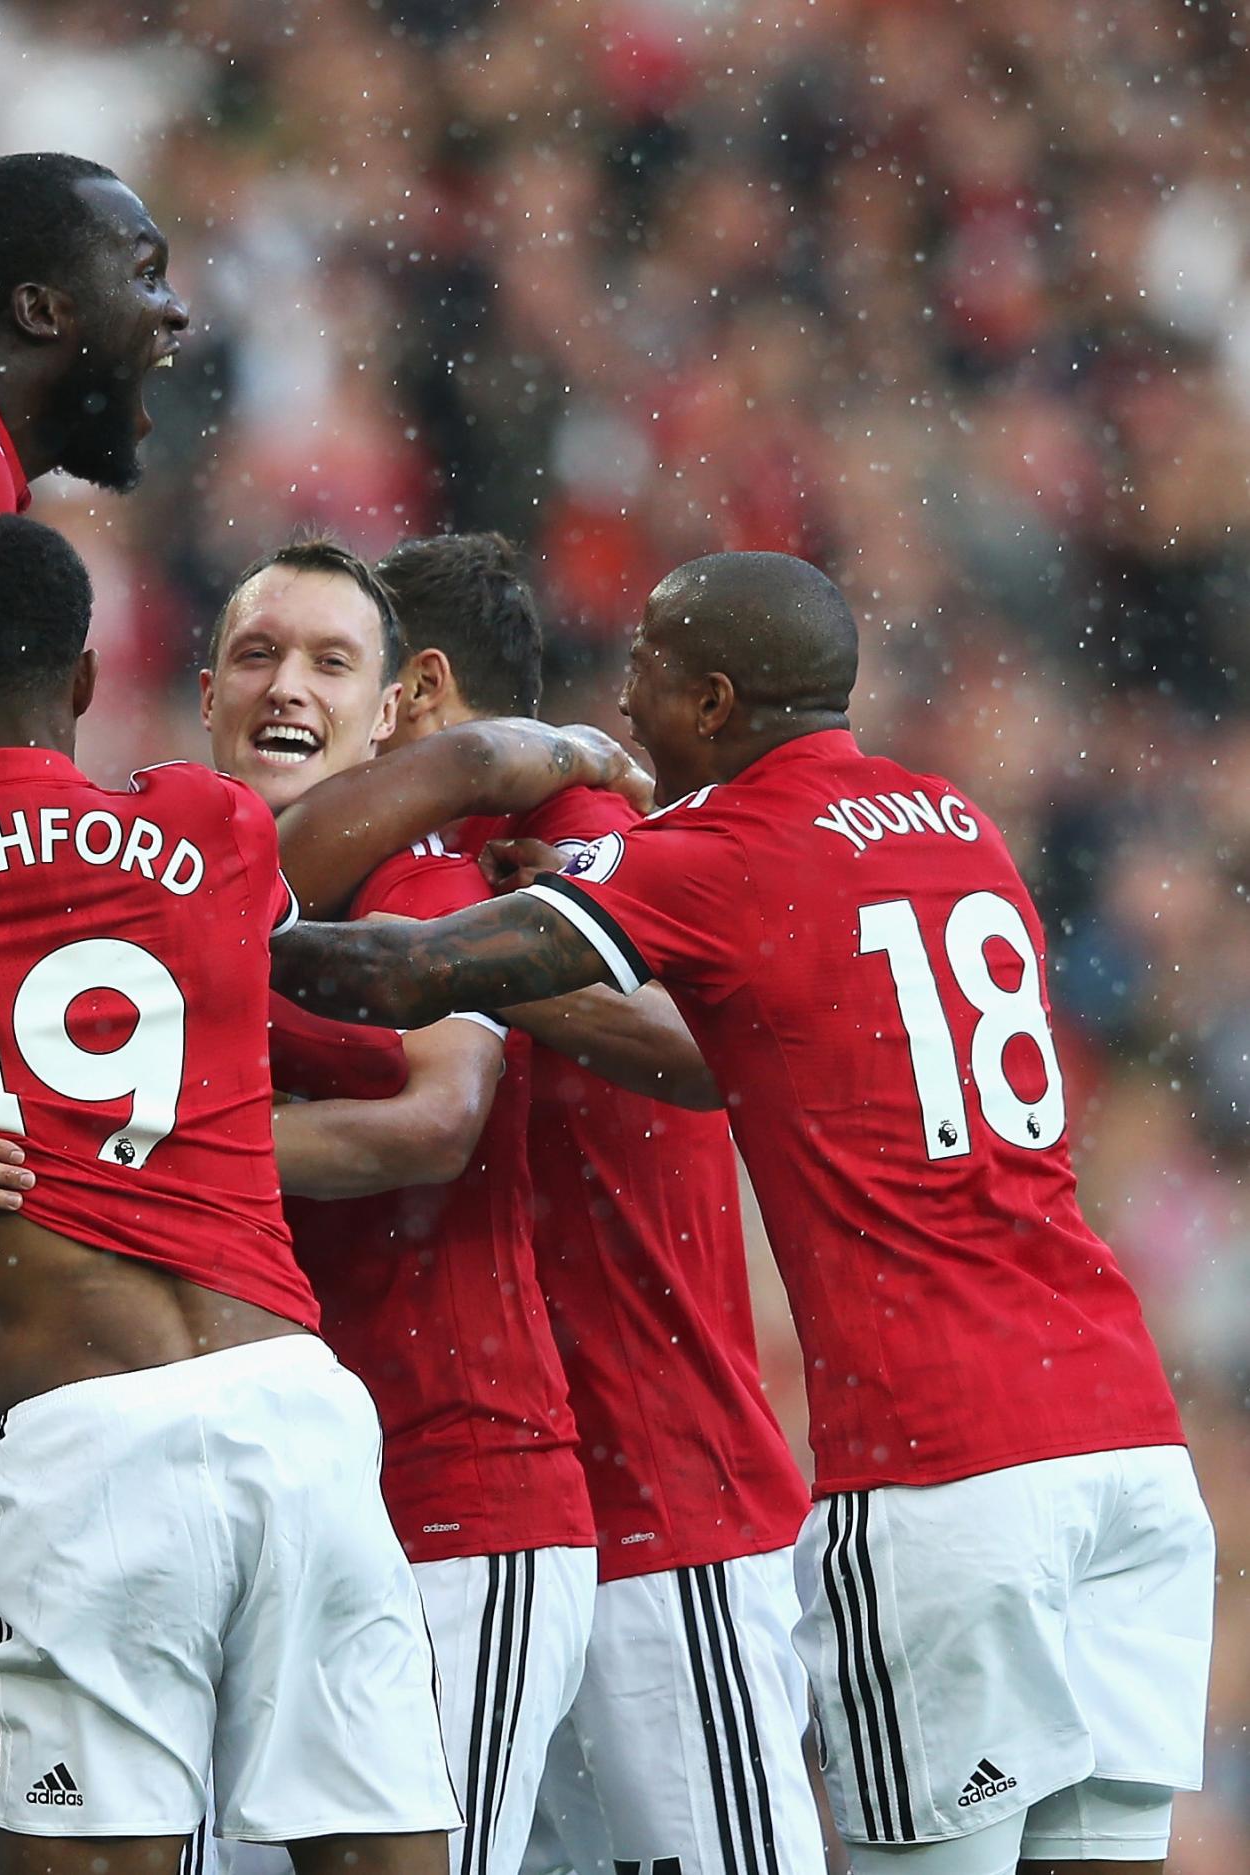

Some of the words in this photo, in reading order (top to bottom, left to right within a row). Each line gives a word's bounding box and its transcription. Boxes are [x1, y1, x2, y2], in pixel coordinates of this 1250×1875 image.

[813, 791, 980, 851] YOUNG
[858, 891, 1066, 1161] 18
[422, 1523, 460, 1533] adizero
[26, 1789, 84, 1807] adidas
[957, 1777, 1017, 1807] adidas
